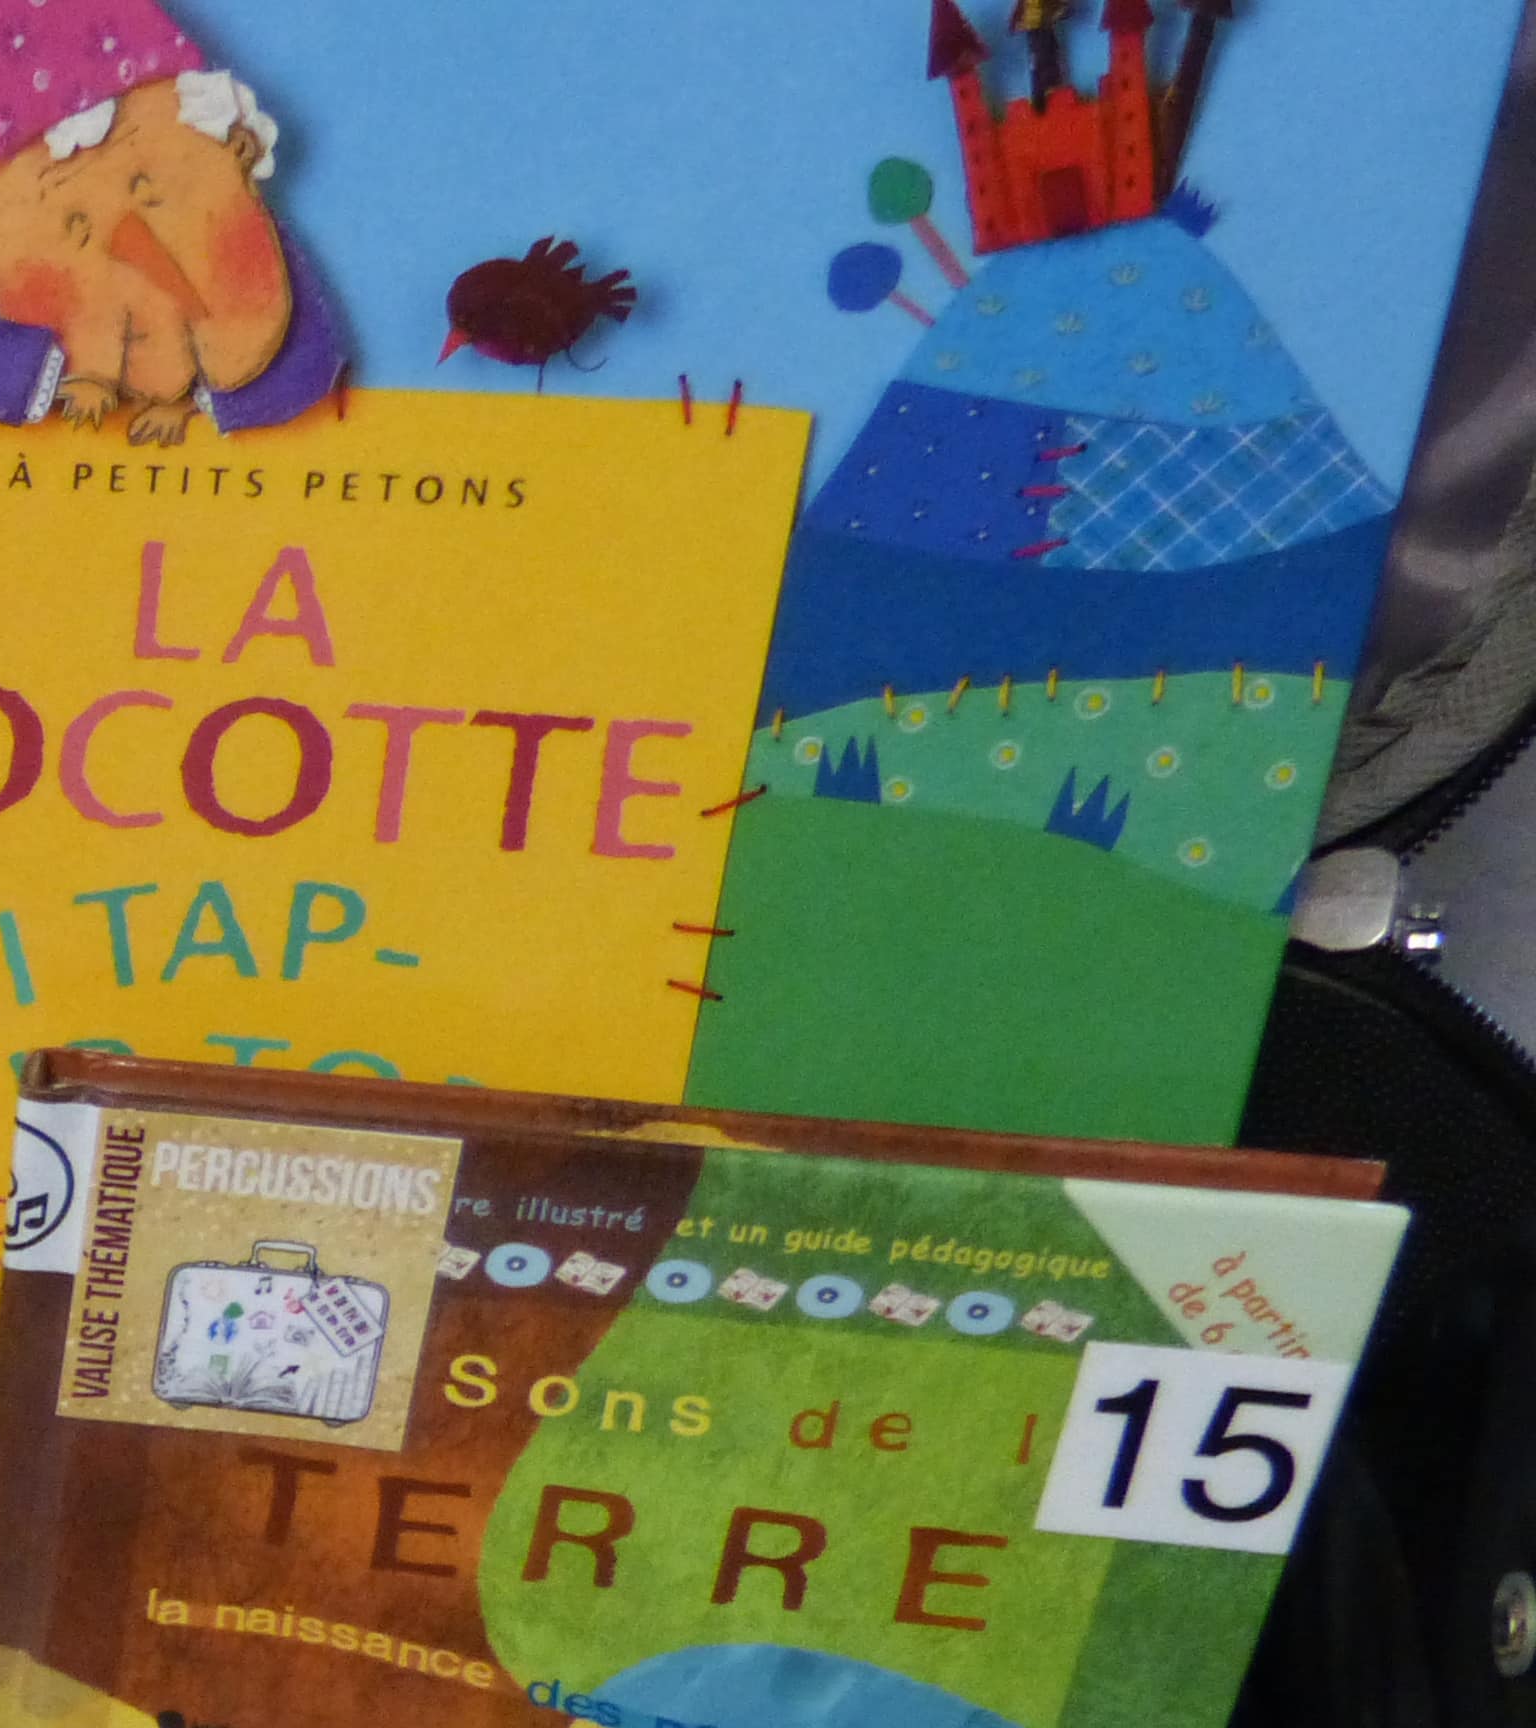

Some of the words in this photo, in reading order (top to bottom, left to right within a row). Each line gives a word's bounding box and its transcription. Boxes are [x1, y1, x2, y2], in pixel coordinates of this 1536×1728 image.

[8, 452, 35, 490] À
[71, 462, 265, 499] PETITS
[303, 471, 529, 511] PETONS
[134, 541, 335, 667] LA
[75, 881, 419, 987] TAP-
[81, 1123, 146, 1303] THÉMATIQUE
[151, 1140, 443, 1216] PERCUSSIONS
[516, 1197, 648, 1233] illustré
[675, 1215, 715, 1240] et
[730, 1224, 769, 1246] un
[784, 1227, 871, 1257] guide
[888, 1233, 1113, 1283] pédagogique
[1169, 1280, 1206, 1321] de
[1219, 1276, 1313, 1361] partir
[71, 1307, 121, 1401] VALISE
[444, 1353, 713, 1438] Sons
[788, 1401, 913, 1452] de
[1094, 1378, 1313, 1524] 15
[238, 1449, 1009, 1632] TERRE
[146, 1587, 190, 1628] la
[214, 1601, 495, 1691] naissance
[527, 1675, 624, 1728] des
